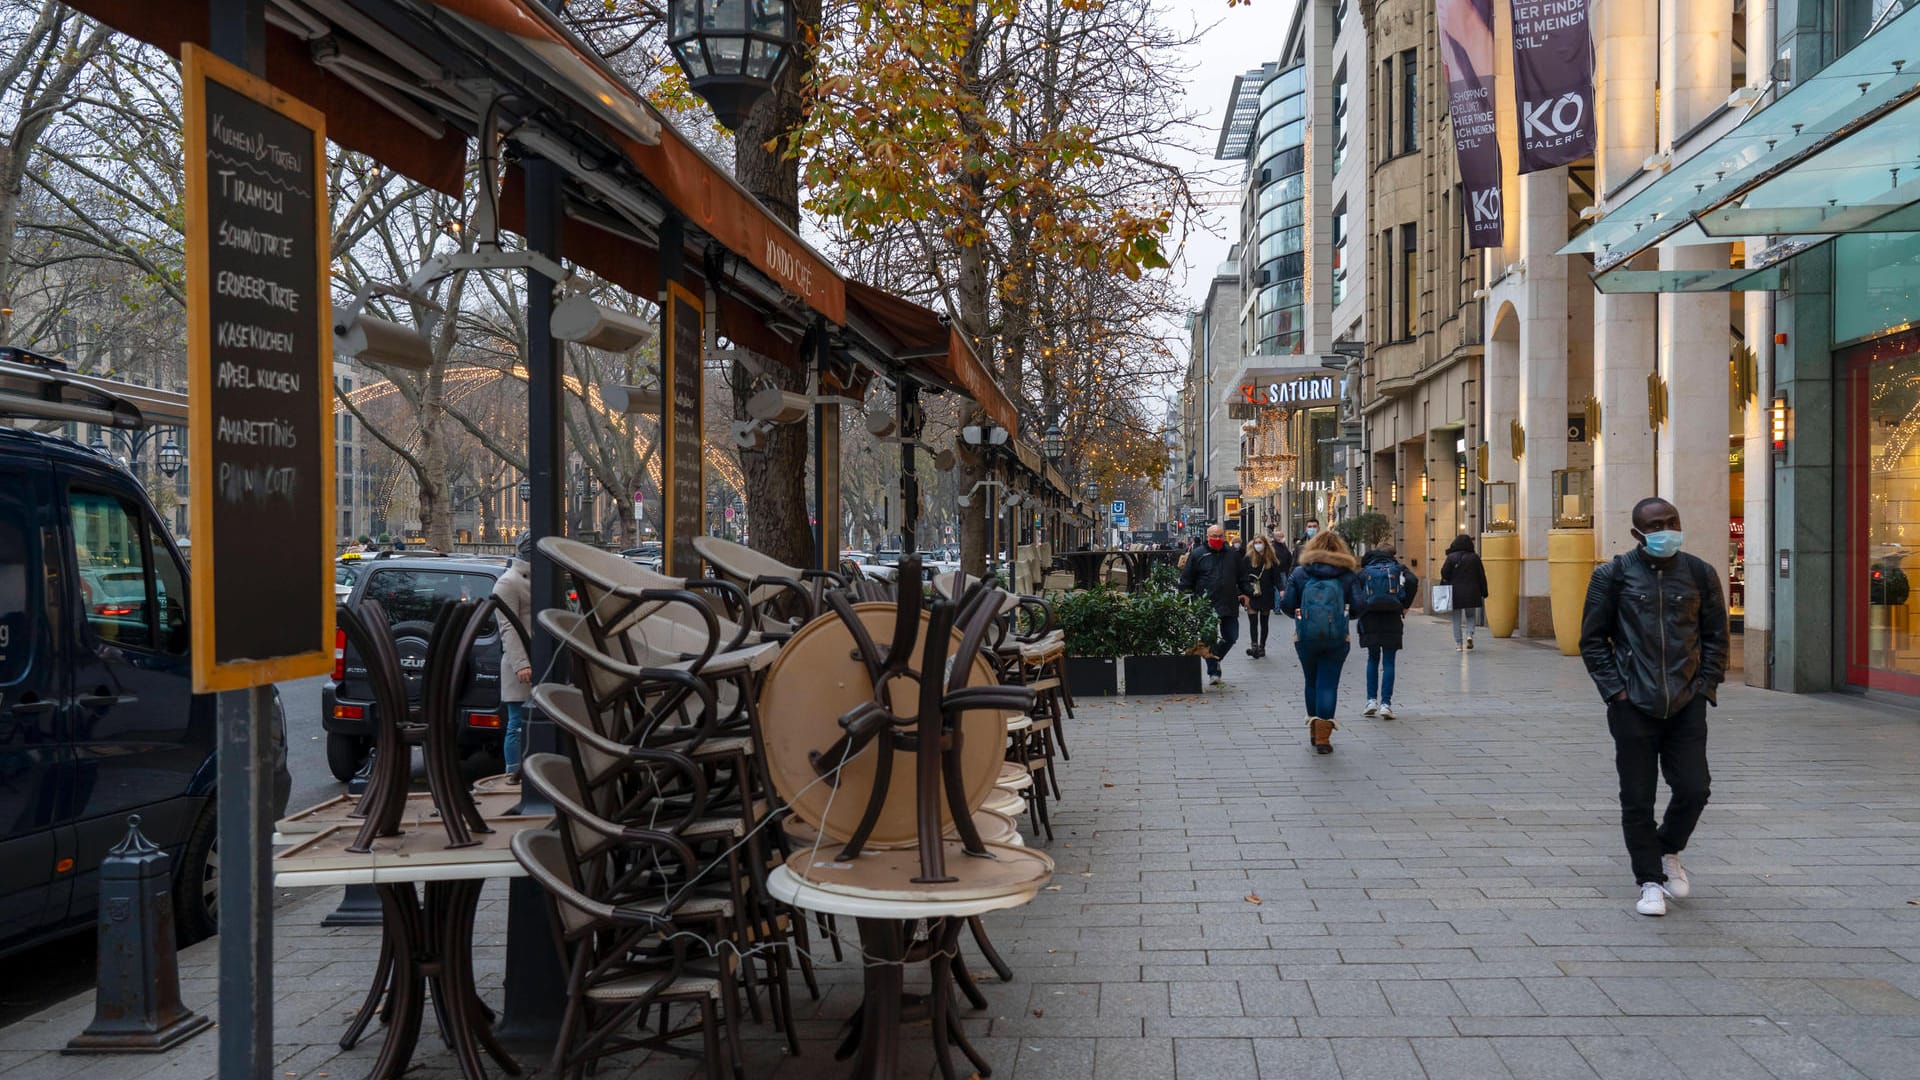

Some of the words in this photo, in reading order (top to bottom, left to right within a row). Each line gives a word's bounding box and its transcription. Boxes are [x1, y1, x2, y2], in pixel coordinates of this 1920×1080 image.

[1543, 0, 1584, 16] FINDE
[1534, 9, 1585, 33] MEINEN
[1455, 127, 1472, 139] ICH
[1526, 129, 1585, 150] GALERIE
[218, 170, 283, 215] TIRAMISU
[1269, 379, 1332, 403] SATURN
